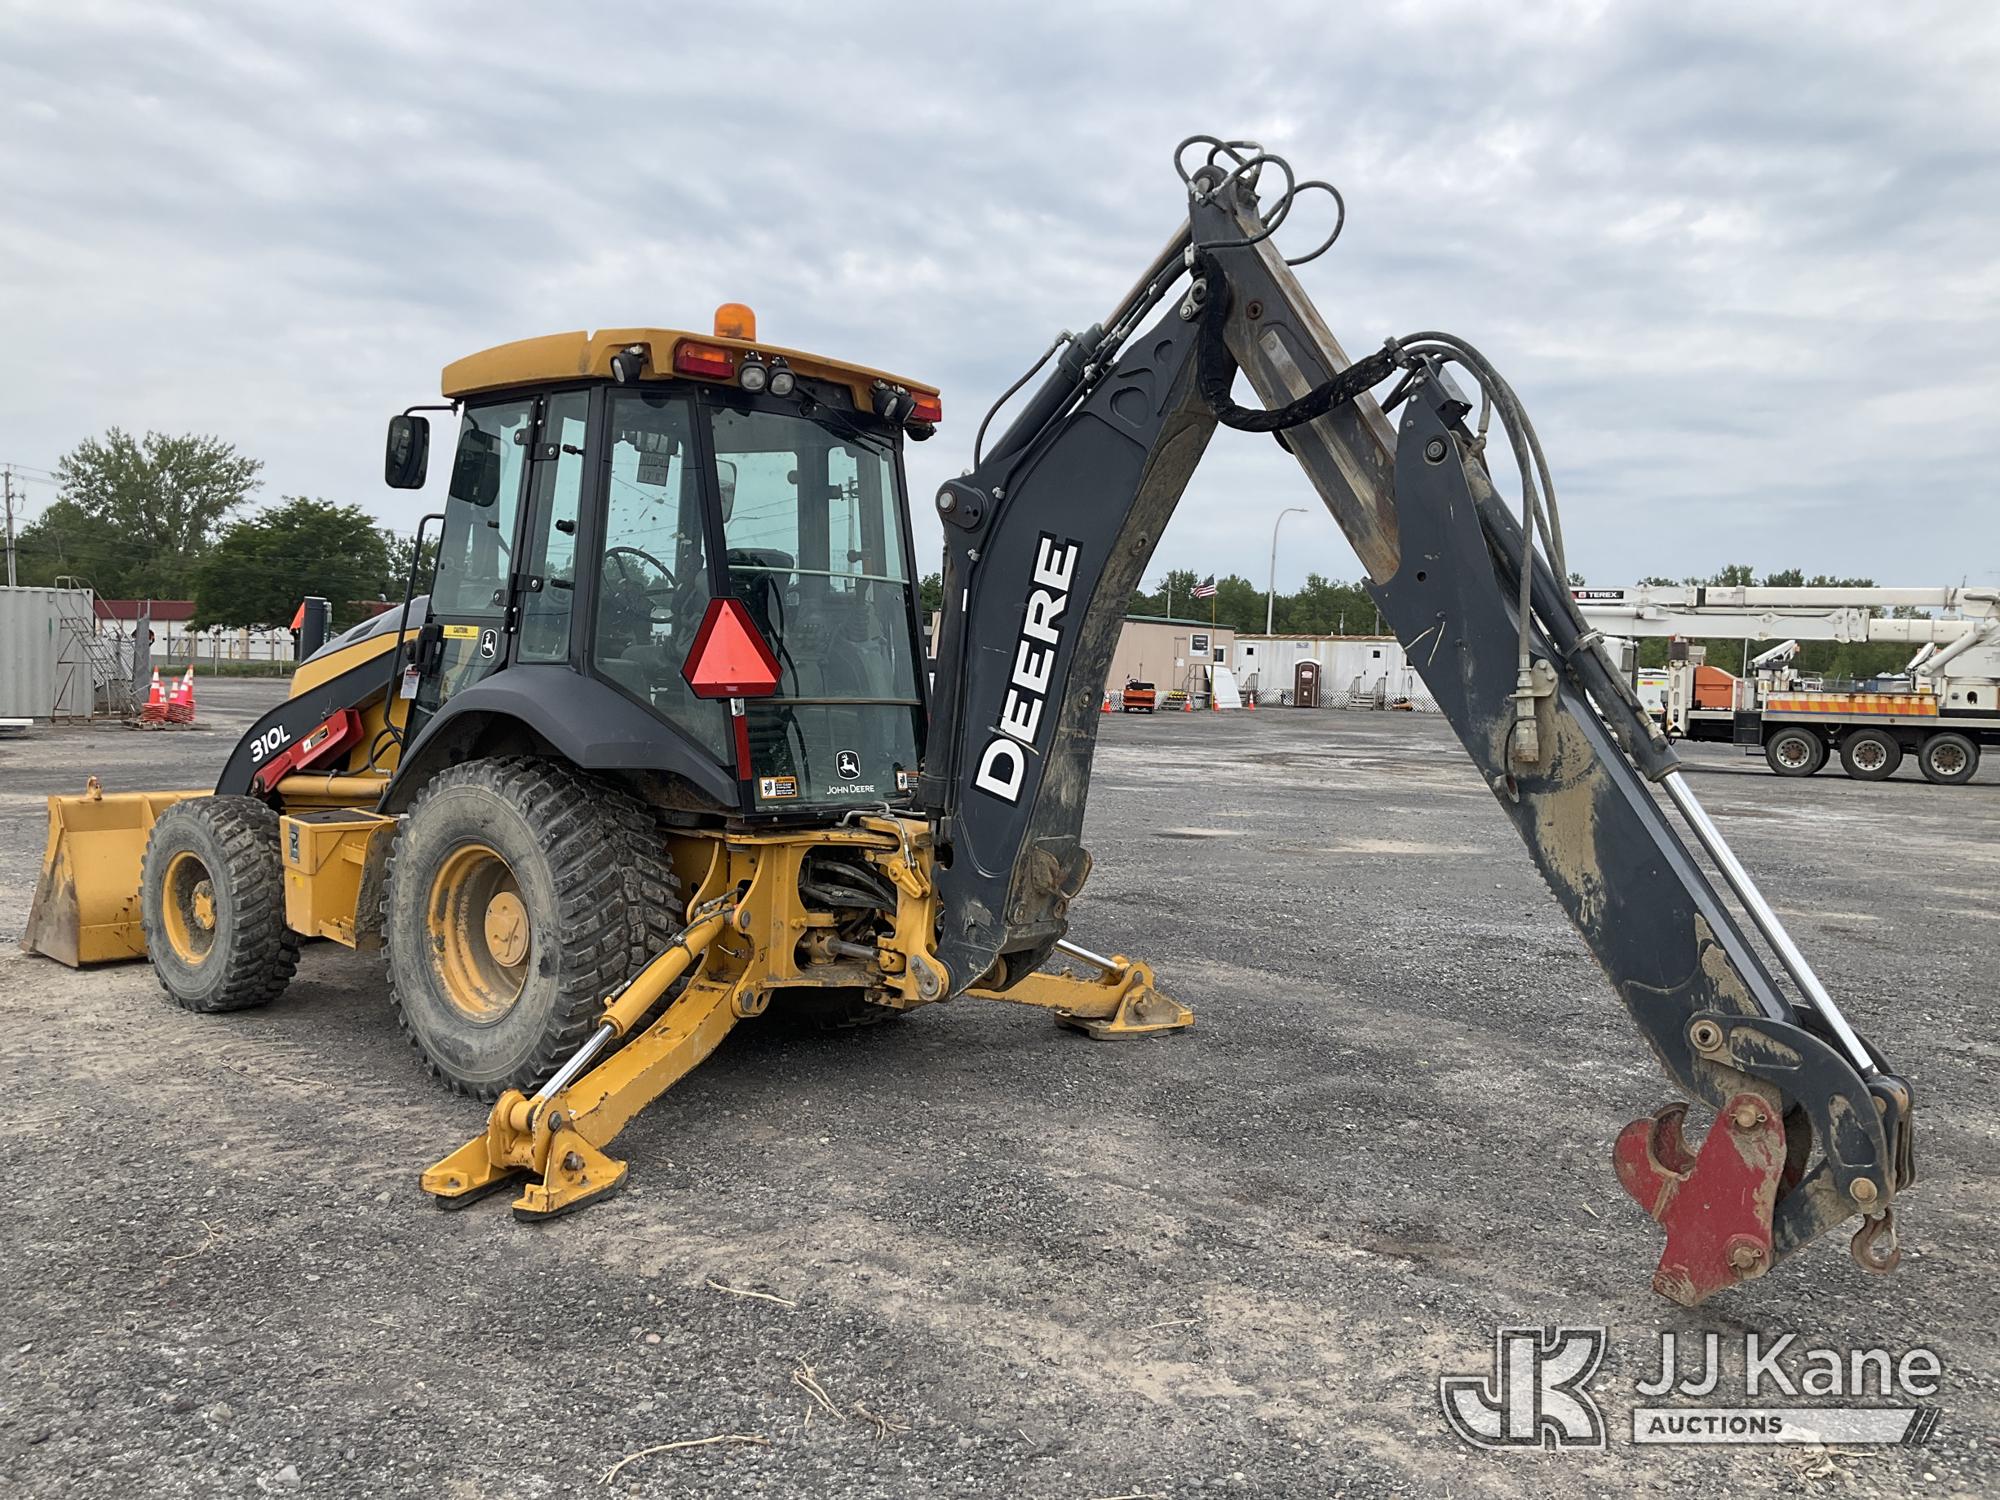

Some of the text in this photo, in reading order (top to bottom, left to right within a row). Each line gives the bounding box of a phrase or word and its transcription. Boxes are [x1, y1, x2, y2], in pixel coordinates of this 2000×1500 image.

[975, 537, 1078, 802] DEERE
[250, 725, 291, 762] 310L
[826, 784, 875, 795] JOHN DEERE
